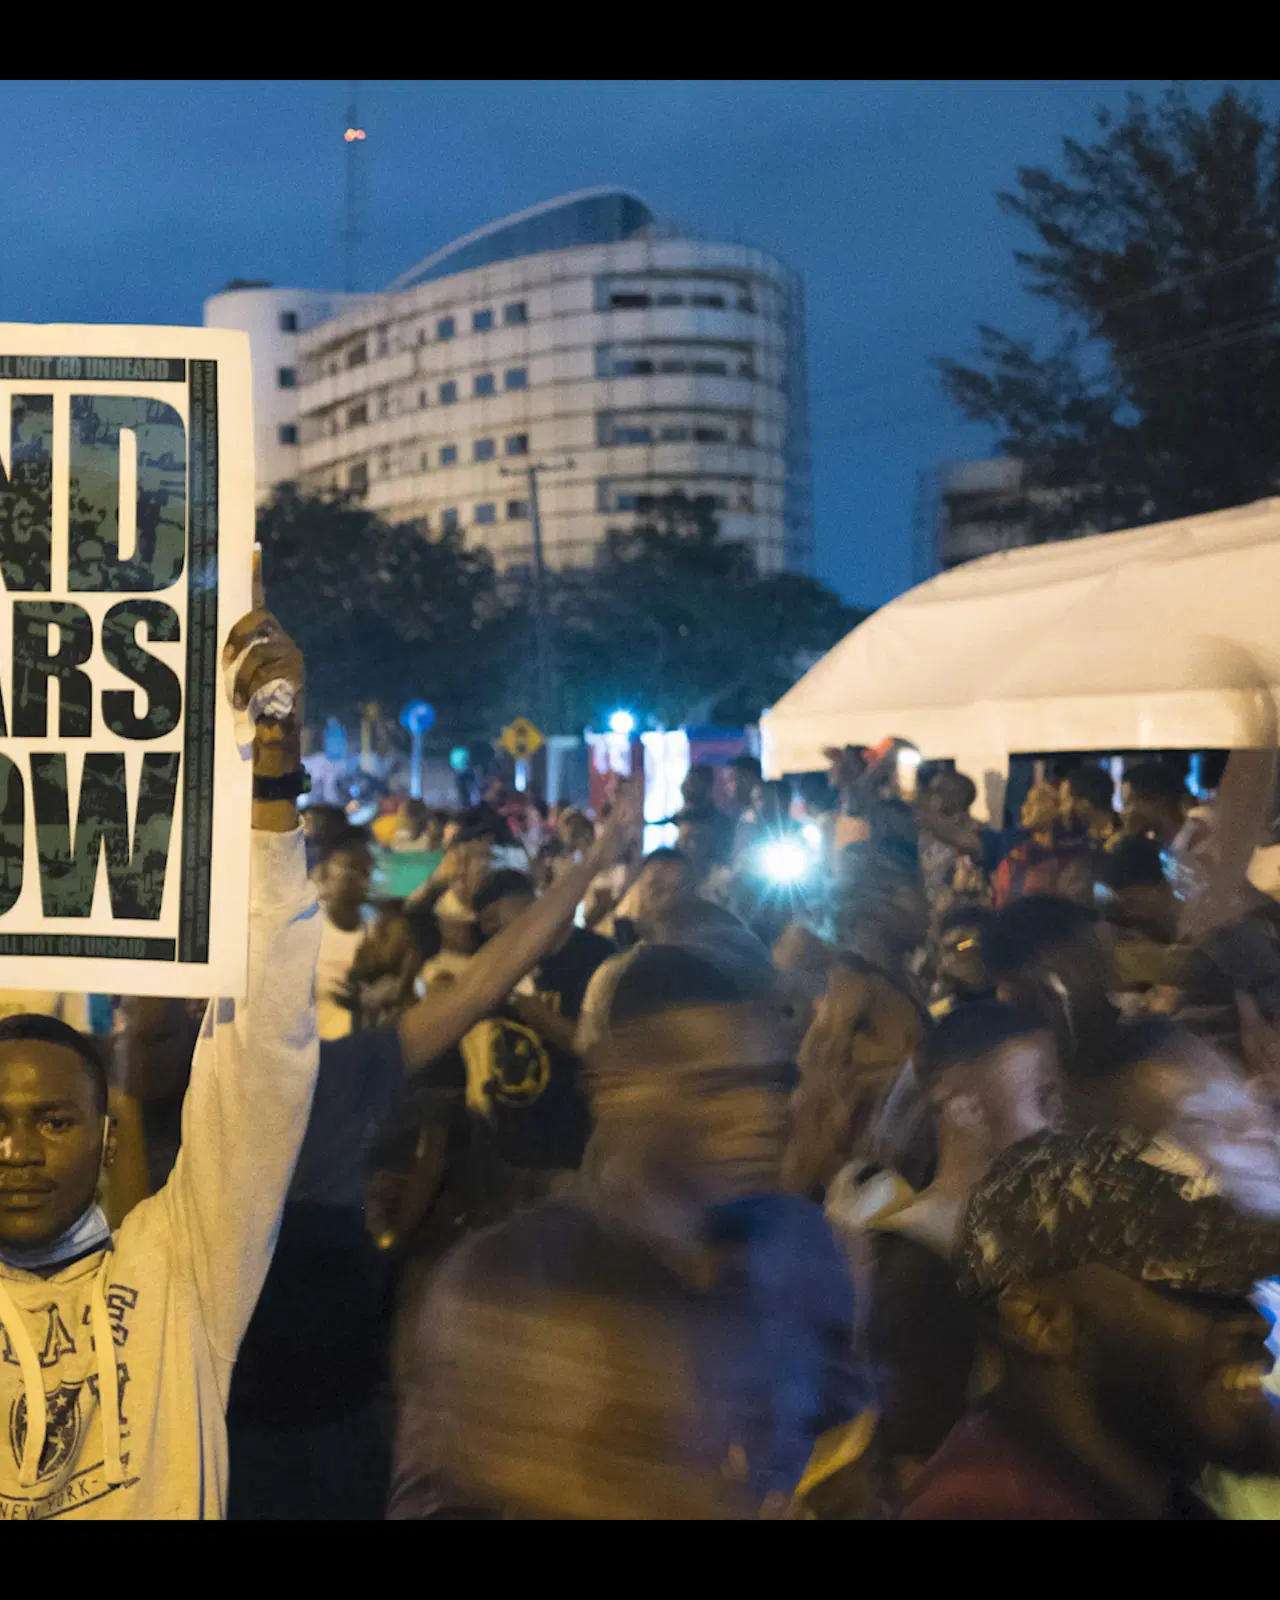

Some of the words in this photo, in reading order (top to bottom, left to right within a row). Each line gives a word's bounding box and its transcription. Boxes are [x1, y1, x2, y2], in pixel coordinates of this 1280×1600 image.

[16, 357, 52, 378] NOT
[56, 357, 81, 378] GO
[85, 358, 169, 380] UNHEARD
[23, 935, 56, 955] NOT
[59, 936, 80, 956] GO
[84, 937, 146, 959] UNSAID
